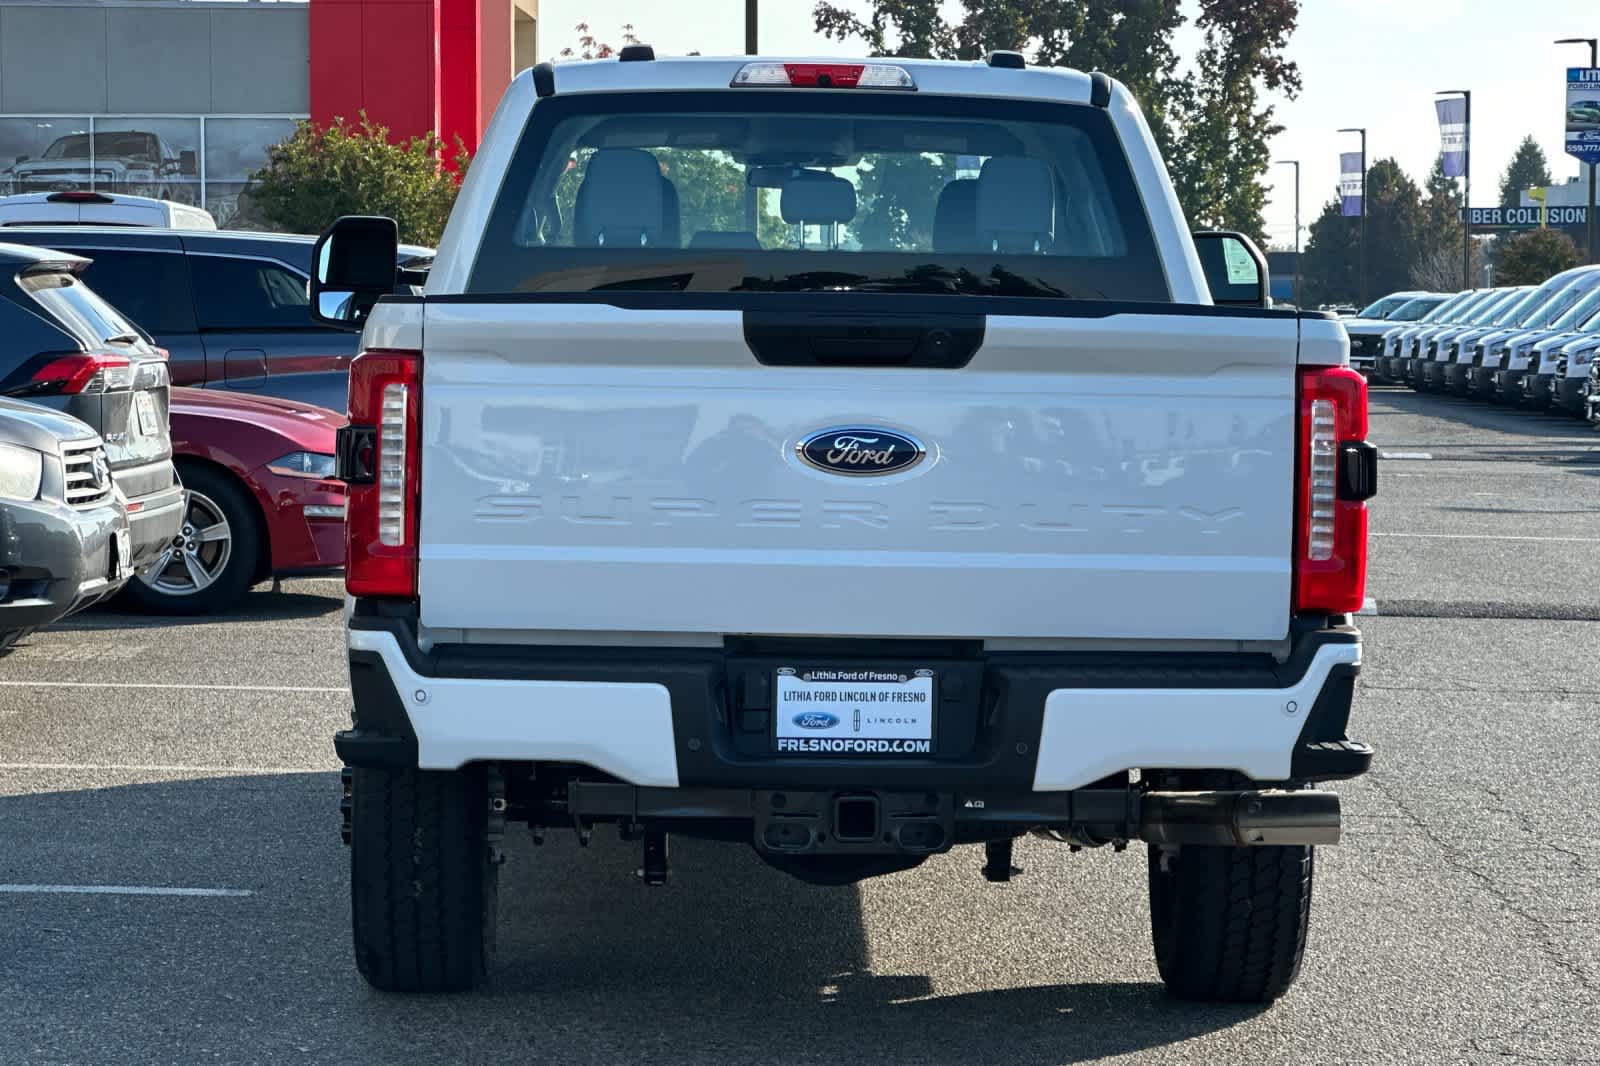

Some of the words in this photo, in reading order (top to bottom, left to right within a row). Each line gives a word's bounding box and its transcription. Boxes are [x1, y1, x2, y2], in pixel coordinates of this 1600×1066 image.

[1506, 207, 1587, 224] COLLISION
[826, 435, 896, 465] Ford
[472, 494, 889, 529] SUPER
[927, 500, 1246, 535] DUTY
[811, 671, 836, 680] Lithia
[838, 671, 857, 680] Ford
[858, 671, 868, 680] of
[869, 672, 898, 681] Fresno
[783, 690, 812, 702] LITHIA
[814, 691, 837, 702] FORD
[839, 691, 877, 702] LINCOLN
[878, 691, 890, 703] OF
[891, 691, 926, 703] FRESNO
[866, 717, 917, 725] LINCOLN
[777, 738, 930, 753] FRESNOFORD.COM
